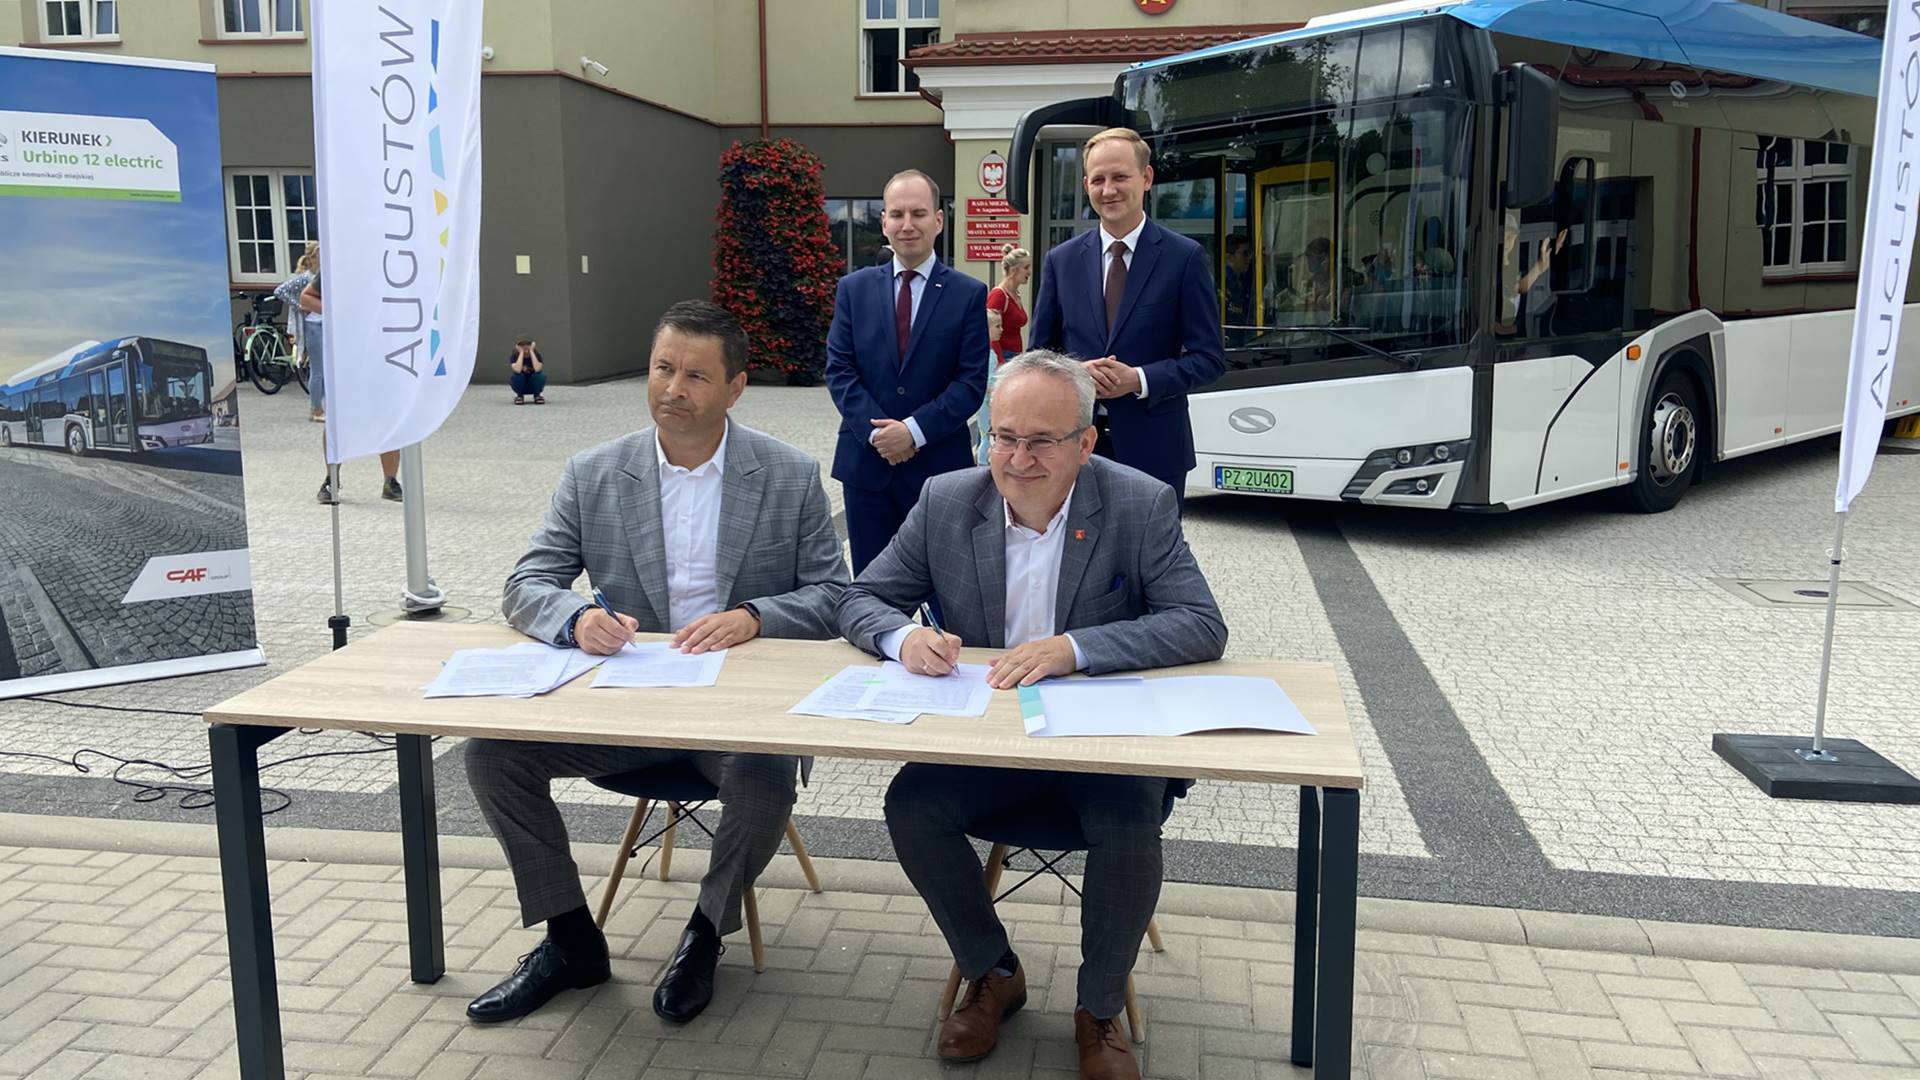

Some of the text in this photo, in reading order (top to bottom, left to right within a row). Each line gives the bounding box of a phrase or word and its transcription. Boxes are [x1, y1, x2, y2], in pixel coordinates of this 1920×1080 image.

[21, 130, 102, 147] KIERUNEK
[23, 150, 78, 165] Urbino
[83, 153, 100, 166] 12
[104, 155, 164, 169] electric
[370, 5, 423, 378] AUGUSTÓW
[1224, 469, 1288, 489] PZ 2U402
[167, 568, 207, 583] CAF
